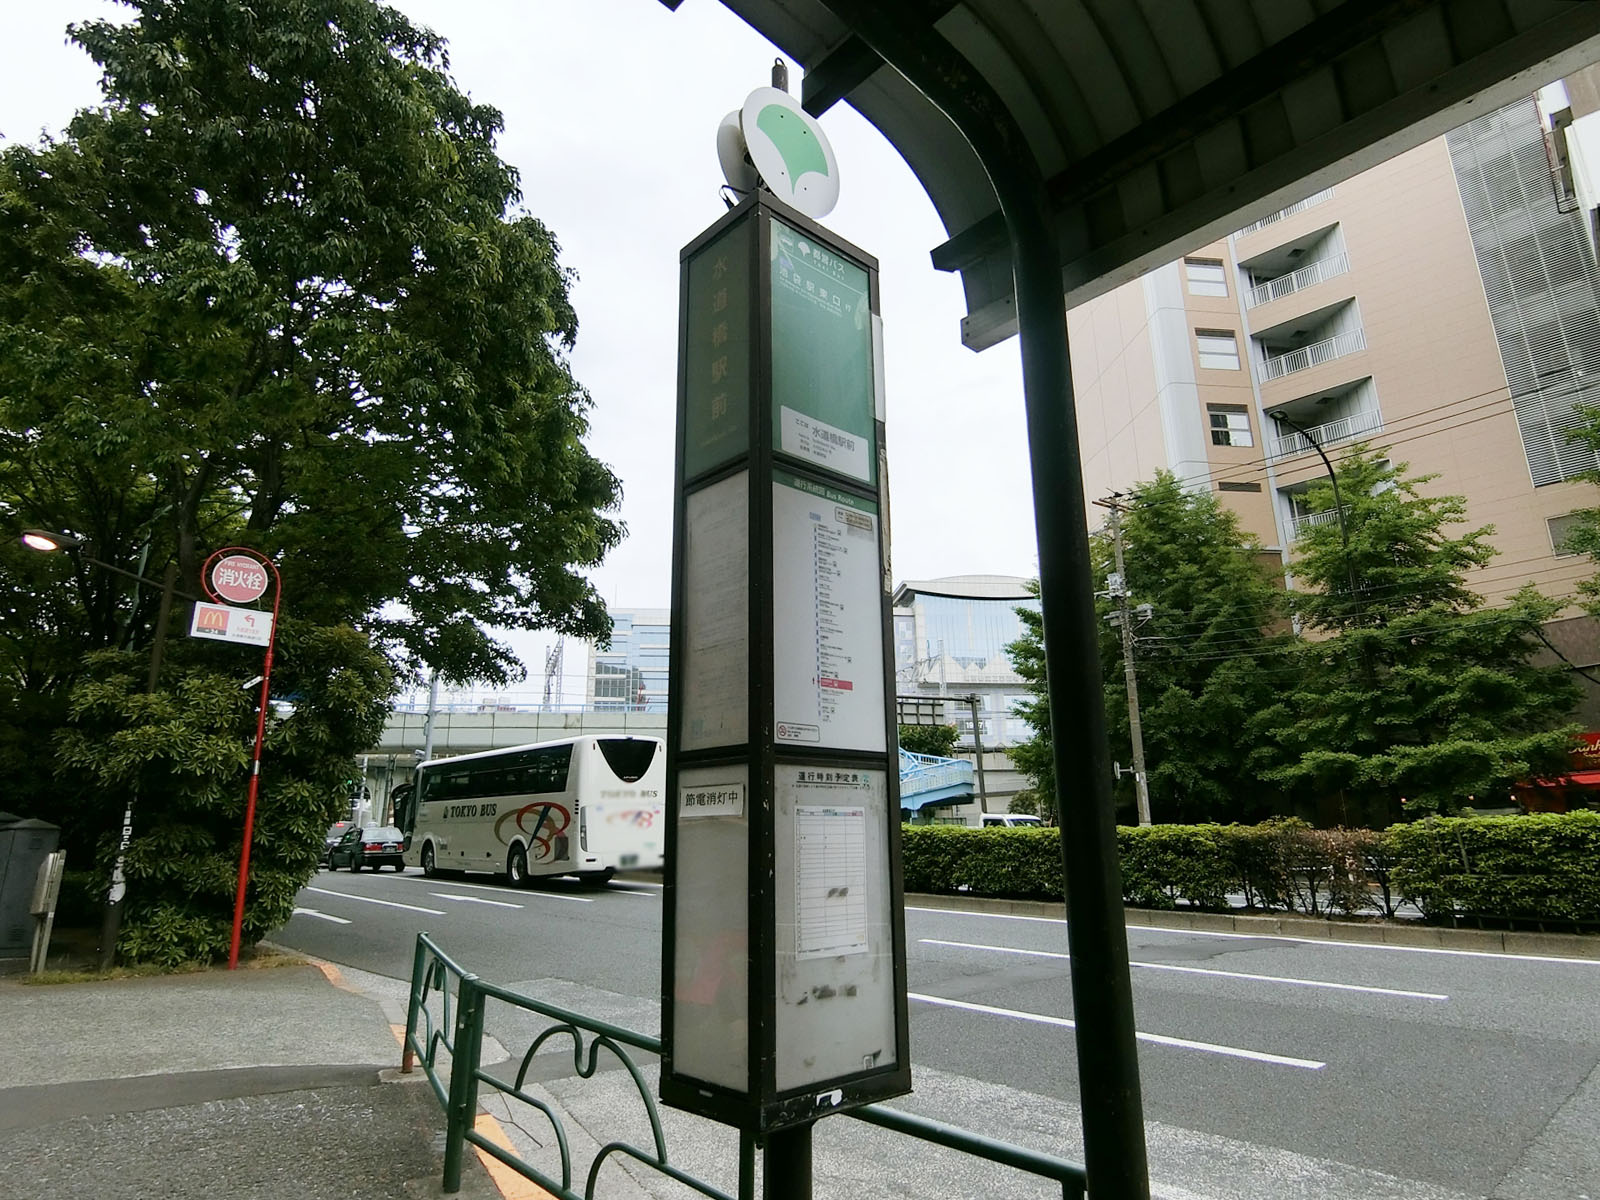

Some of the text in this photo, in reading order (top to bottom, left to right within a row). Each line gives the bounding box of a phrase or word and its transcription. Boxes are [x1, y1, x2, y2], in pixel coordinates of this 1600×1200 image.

[711, 256, 728, 421] 水道橋駅前
[811, 426, 855, 452] 水道橋駅前
[826, 489, 837, 500] Bus
[838, 493, 854, 506] Route
[218, 567, 263, 590] 消火栓
[965, 721, 983, 729] 197
[798, 771, 859, 782] 運行時刻予定表
[685, 790, 738, 807] 節電消灯中
[450, 803, 498, 818] TOKYO BUS
